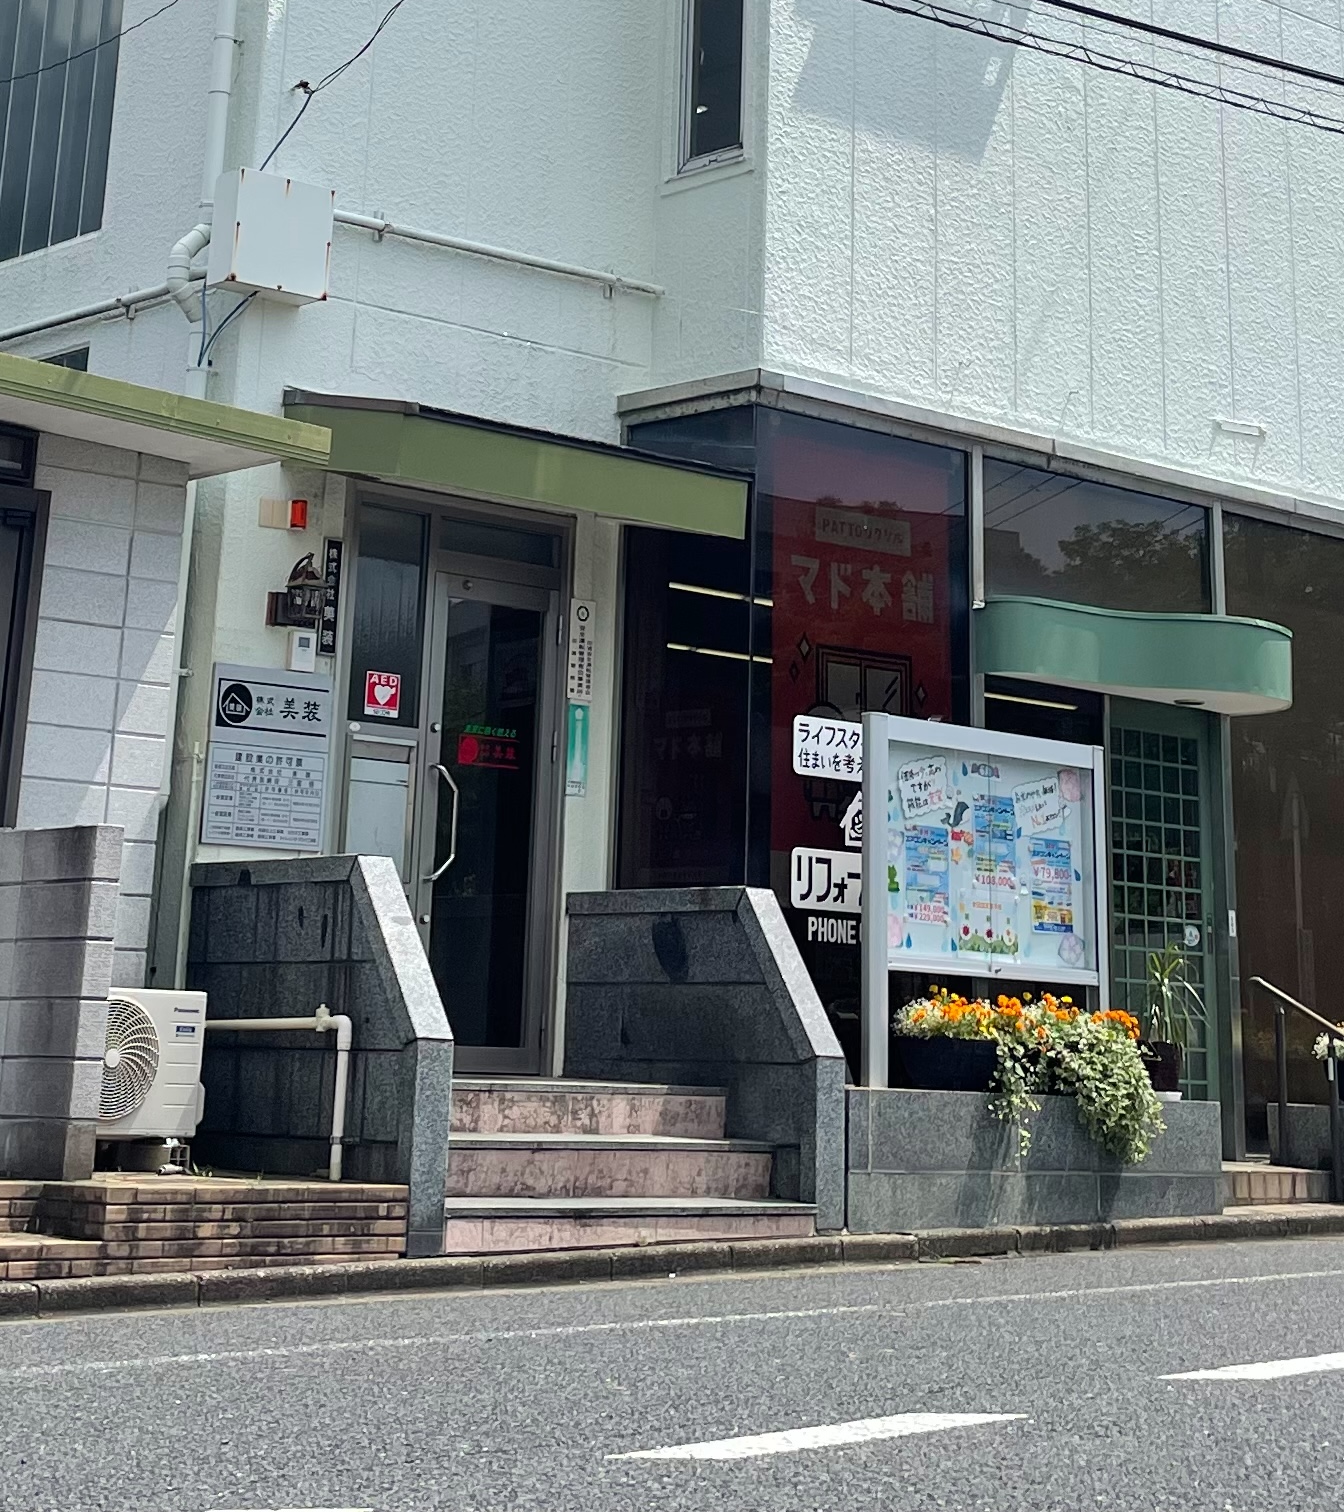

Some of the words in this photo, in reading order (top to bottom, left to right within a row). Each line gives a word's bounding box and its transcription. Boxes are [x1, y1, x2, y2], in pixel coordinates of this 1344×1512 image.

[791, 554, 935, 624] マド本舗
[369, 675, 397, 686] AED
[279, 697, 322, 722] 美装
[798, 722, 863, 749] ライフスタ
[797, 855, 862, 906] リフォー
[807, 916, 856, 945] PHONE
